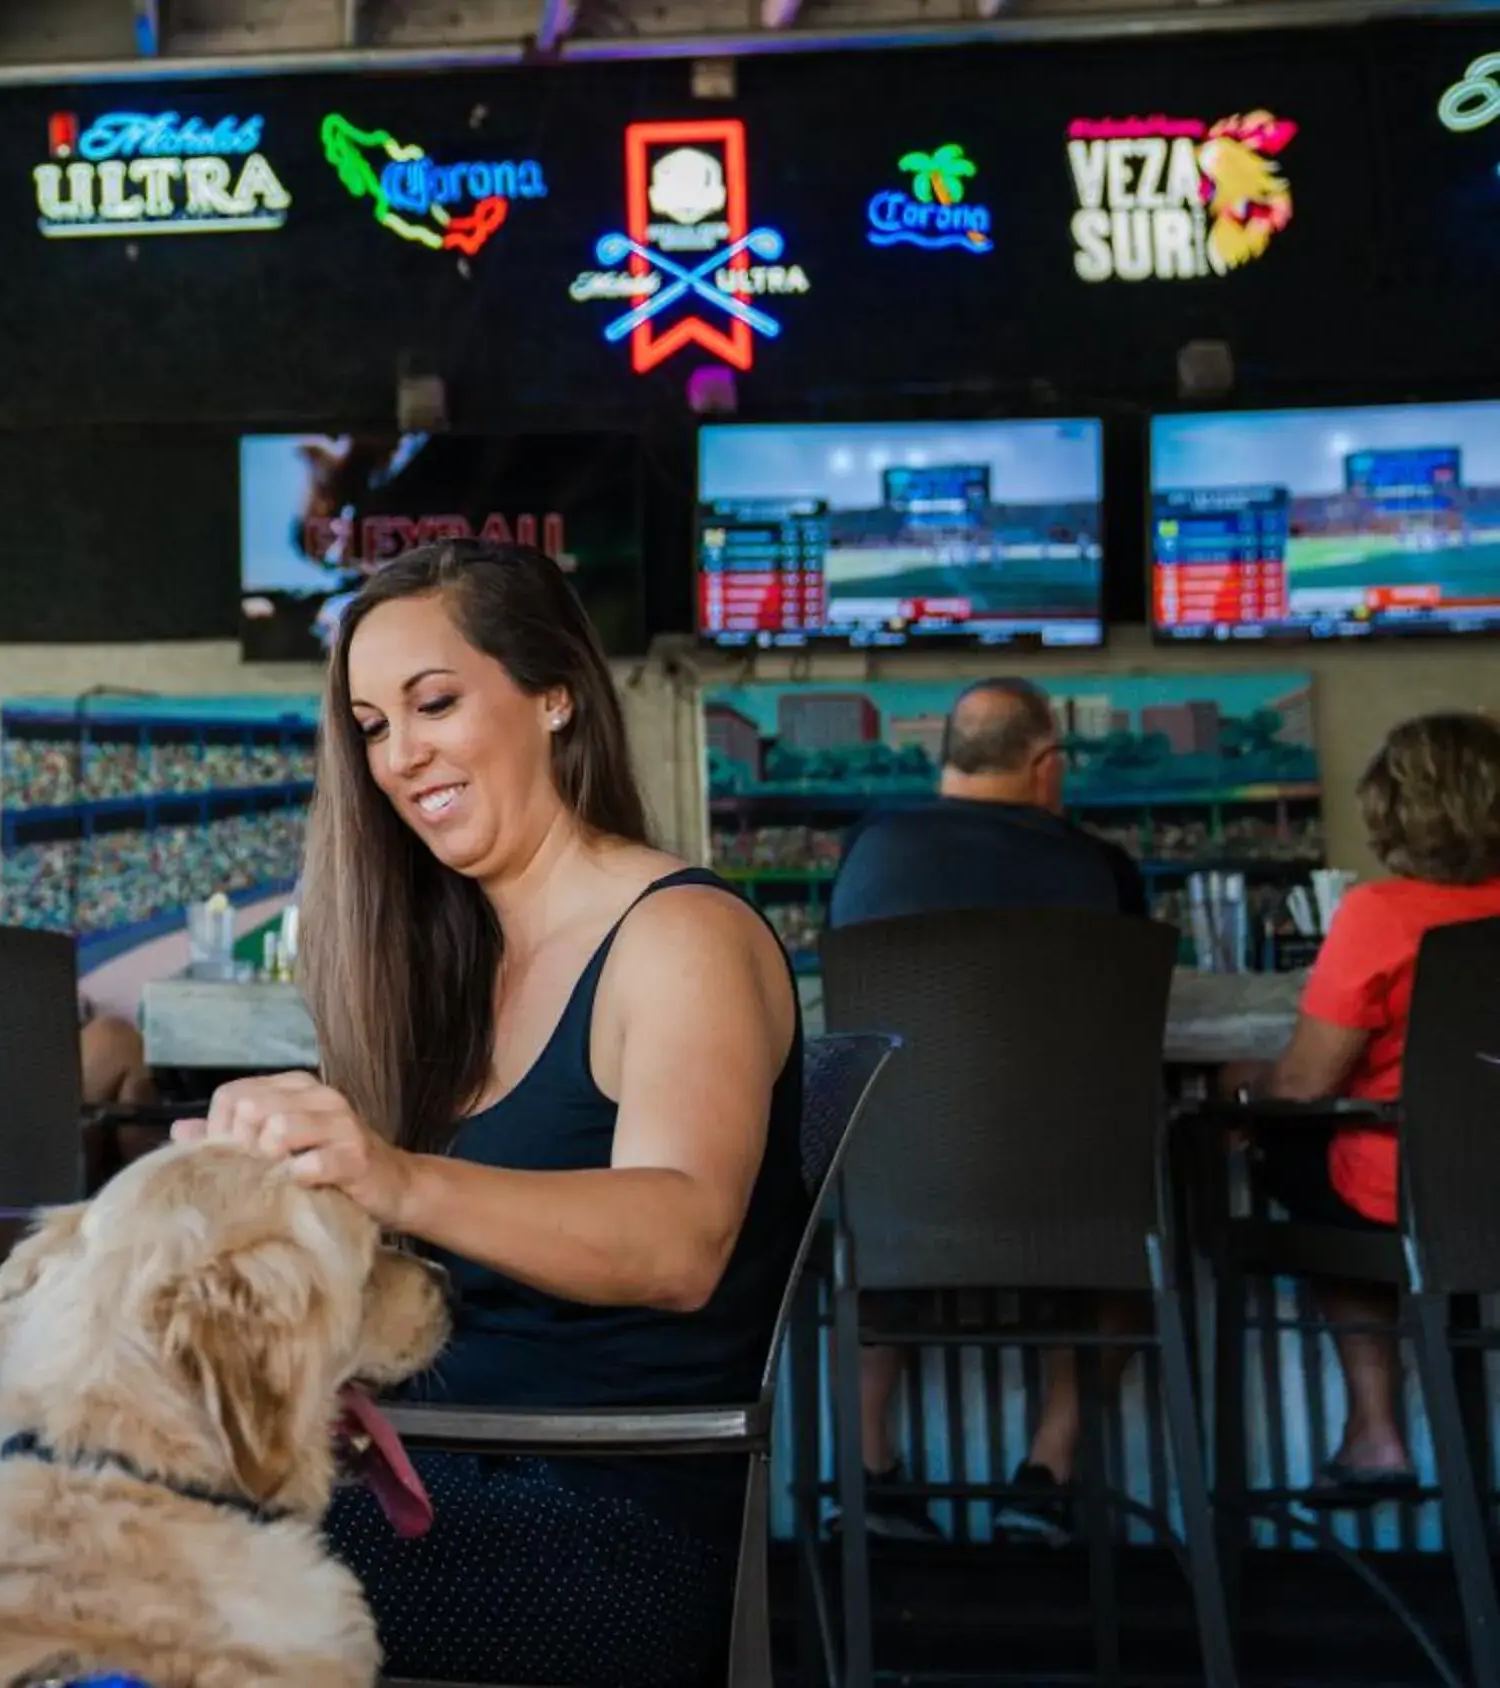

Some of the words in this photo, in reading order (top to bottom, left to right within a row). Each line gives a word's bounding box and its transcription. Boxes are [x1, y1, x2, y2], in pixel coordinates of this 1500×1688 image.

[33, 153, 292, 221] ULTRA
[381, 158, 547, 213] Corona
[1067, 138, 1200, 208] VEZA
[867, 191, 991, 233] Corona
[1071, 207, 1196, 282] SUR
[714, 264, 810, 294] ULTRA
